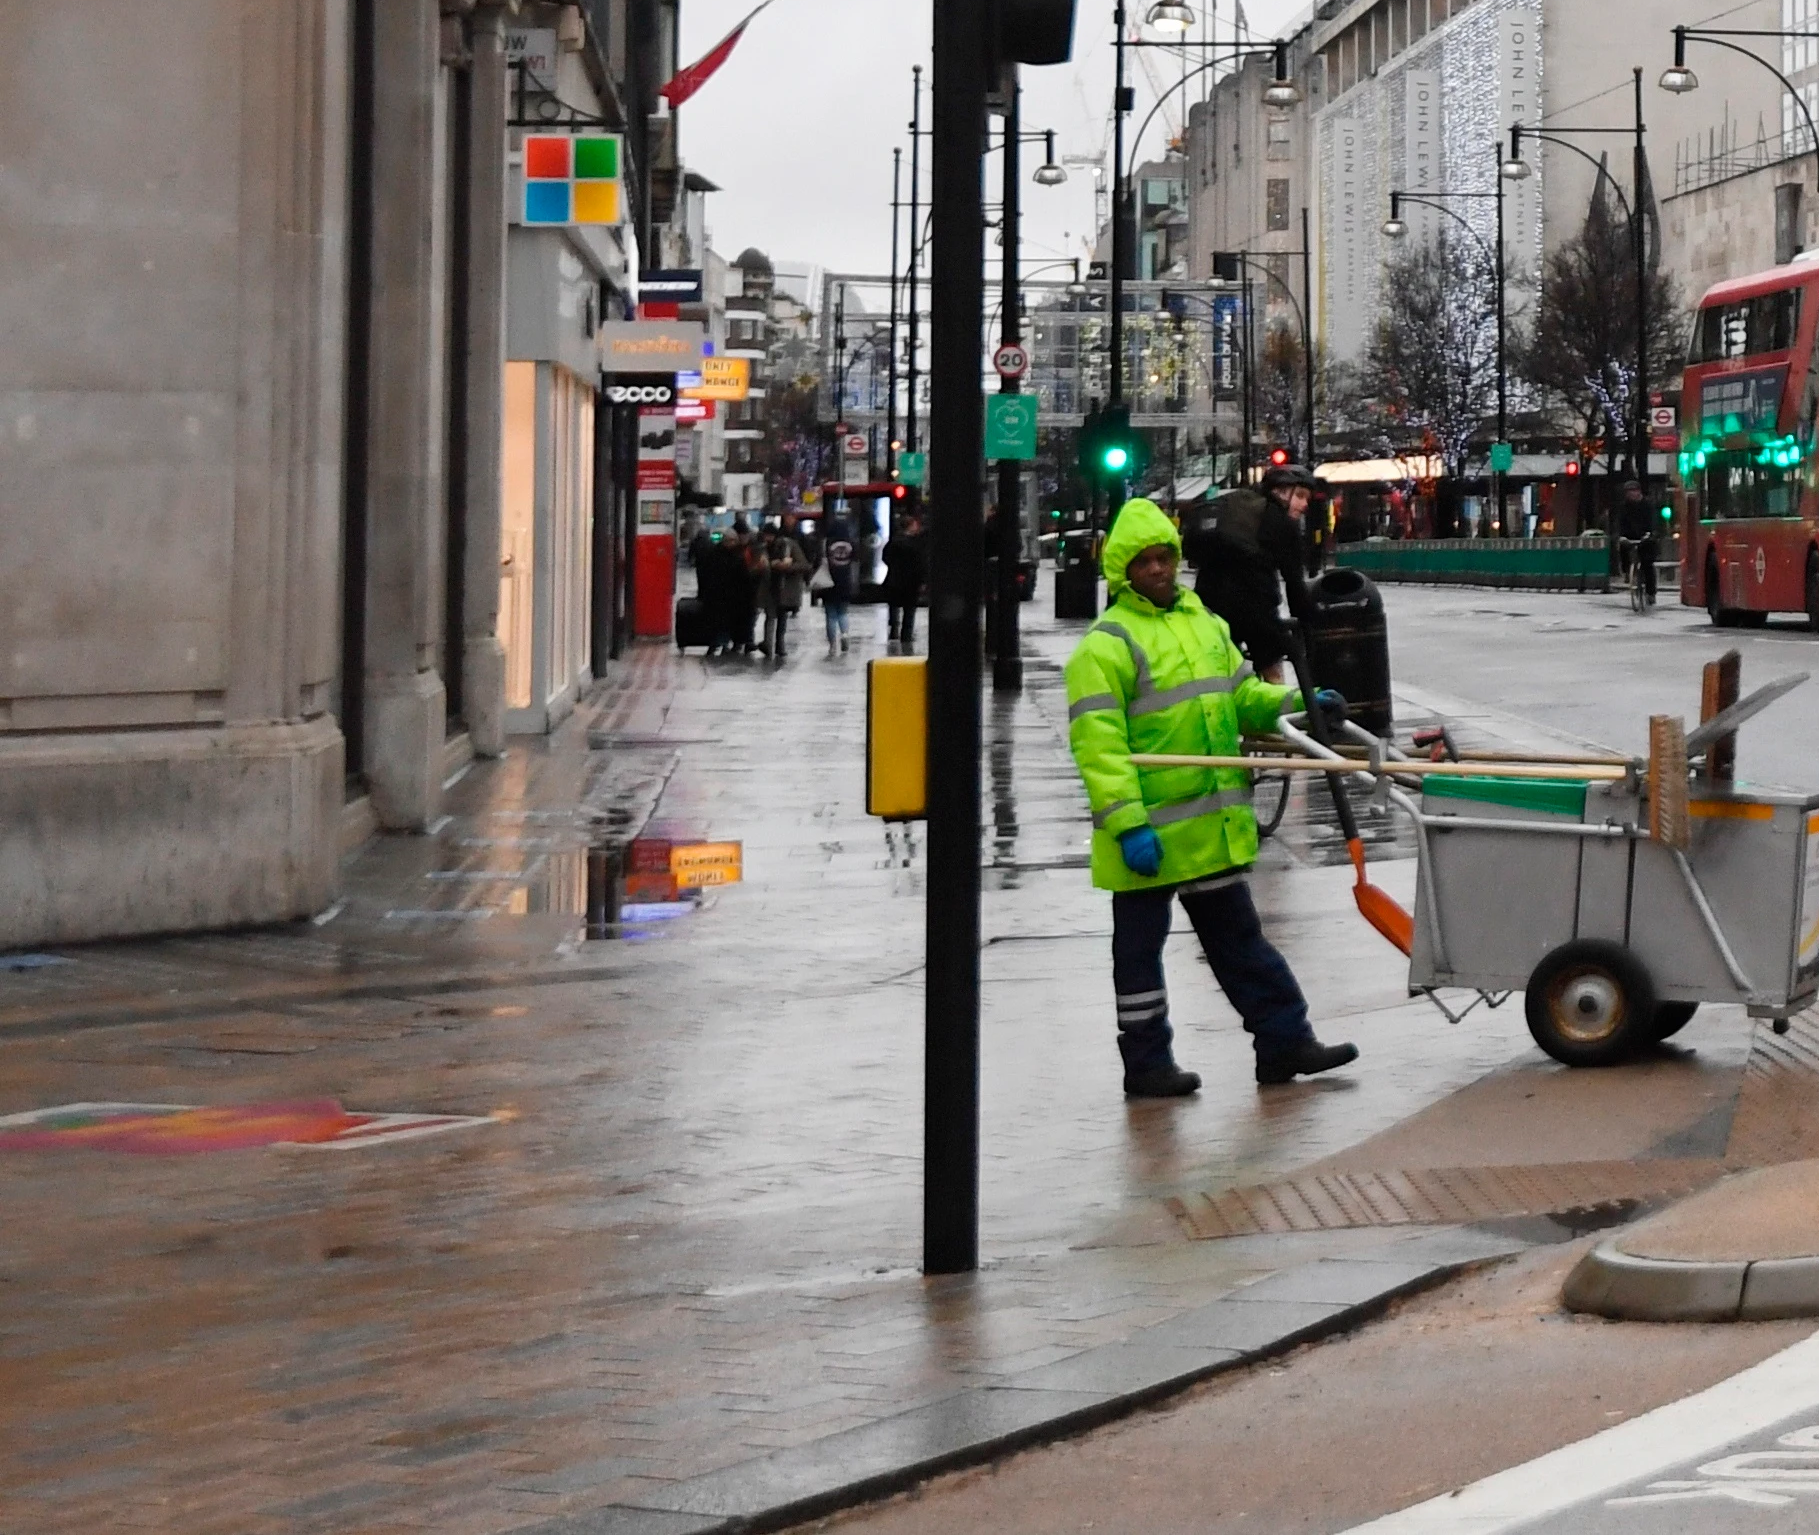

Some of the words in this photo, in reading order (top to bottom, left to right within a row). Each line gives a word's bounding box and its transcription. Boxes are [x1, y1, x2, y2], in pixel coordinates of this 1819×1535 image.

[1511, 22, 1525, 79] JOHN
[1417, 81, 1430, 132] JOHN
[1343, 128, 1355, 174] JOHN
[1417, 140, 1430, 189] LEWI
[1343, 181, 1355, 234] LEWIS
[1000, 353, 1023, 367] 20
[606, 386, 671, 403] ecco
